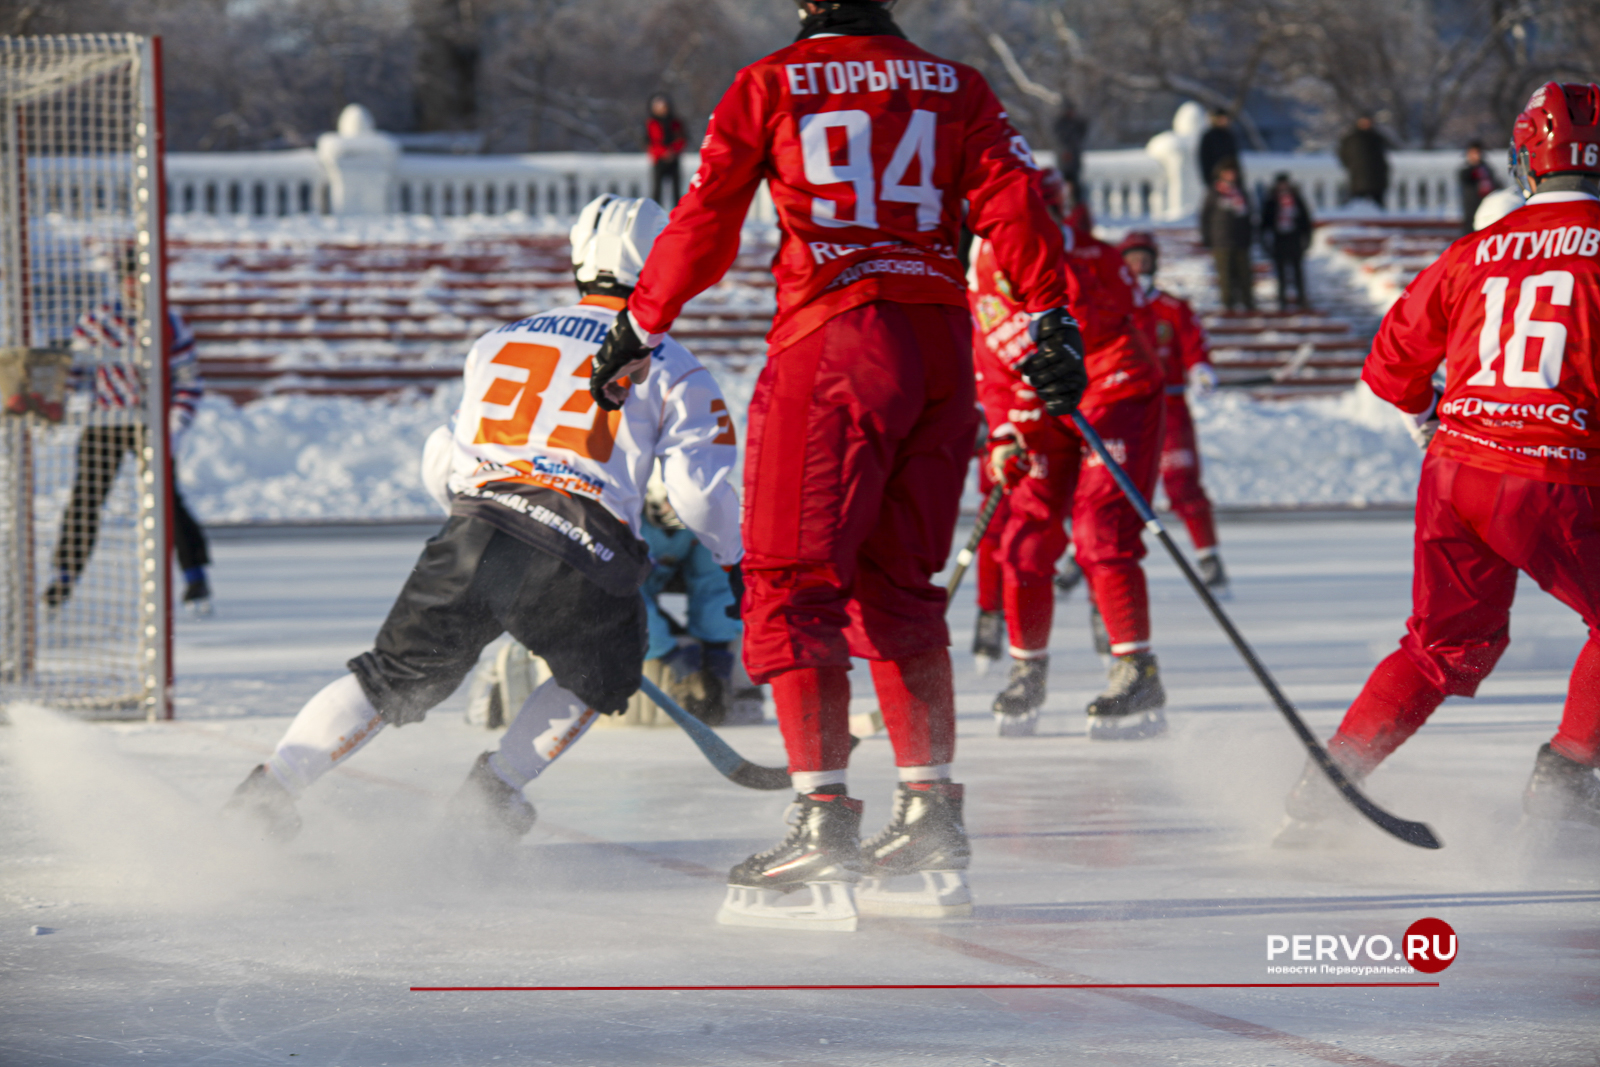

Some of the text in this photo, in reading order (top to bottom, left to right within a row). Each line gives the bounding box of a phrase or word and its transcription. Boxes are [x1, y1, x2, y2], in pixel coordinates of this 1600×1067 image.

[785, 59, 959, 96] ЕГОРЫЧЕВ
[800, 108, 944, 232] 94
[1569, 142, 1599, 167] 16
[1475, 226, 1600, 266] КУТУПОВ
[1466, 270, 1575, 389] 16
[471, 341, 631, 464] 33
